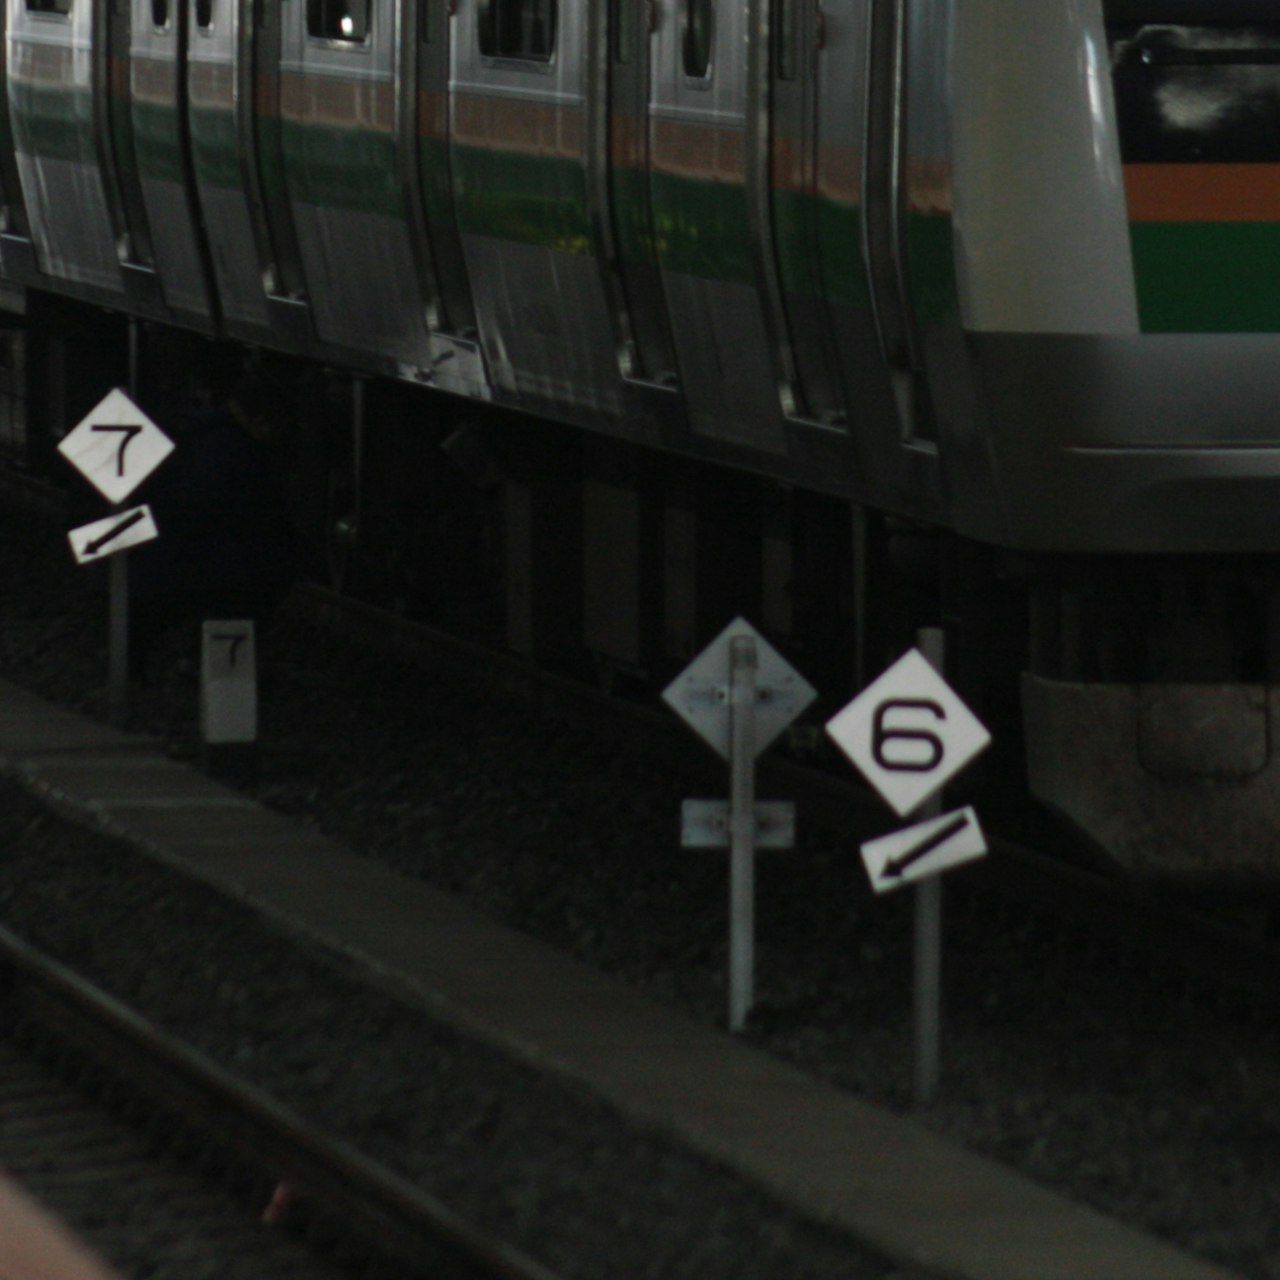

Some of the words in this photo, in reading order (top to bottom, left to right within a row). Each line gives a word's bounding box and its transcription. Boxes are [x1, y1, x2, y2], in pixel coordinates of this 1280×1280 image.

[91, 424, 142, 477] 7
[212, 634, 247, 668] 7
[871, 699, 946, 772] 6
